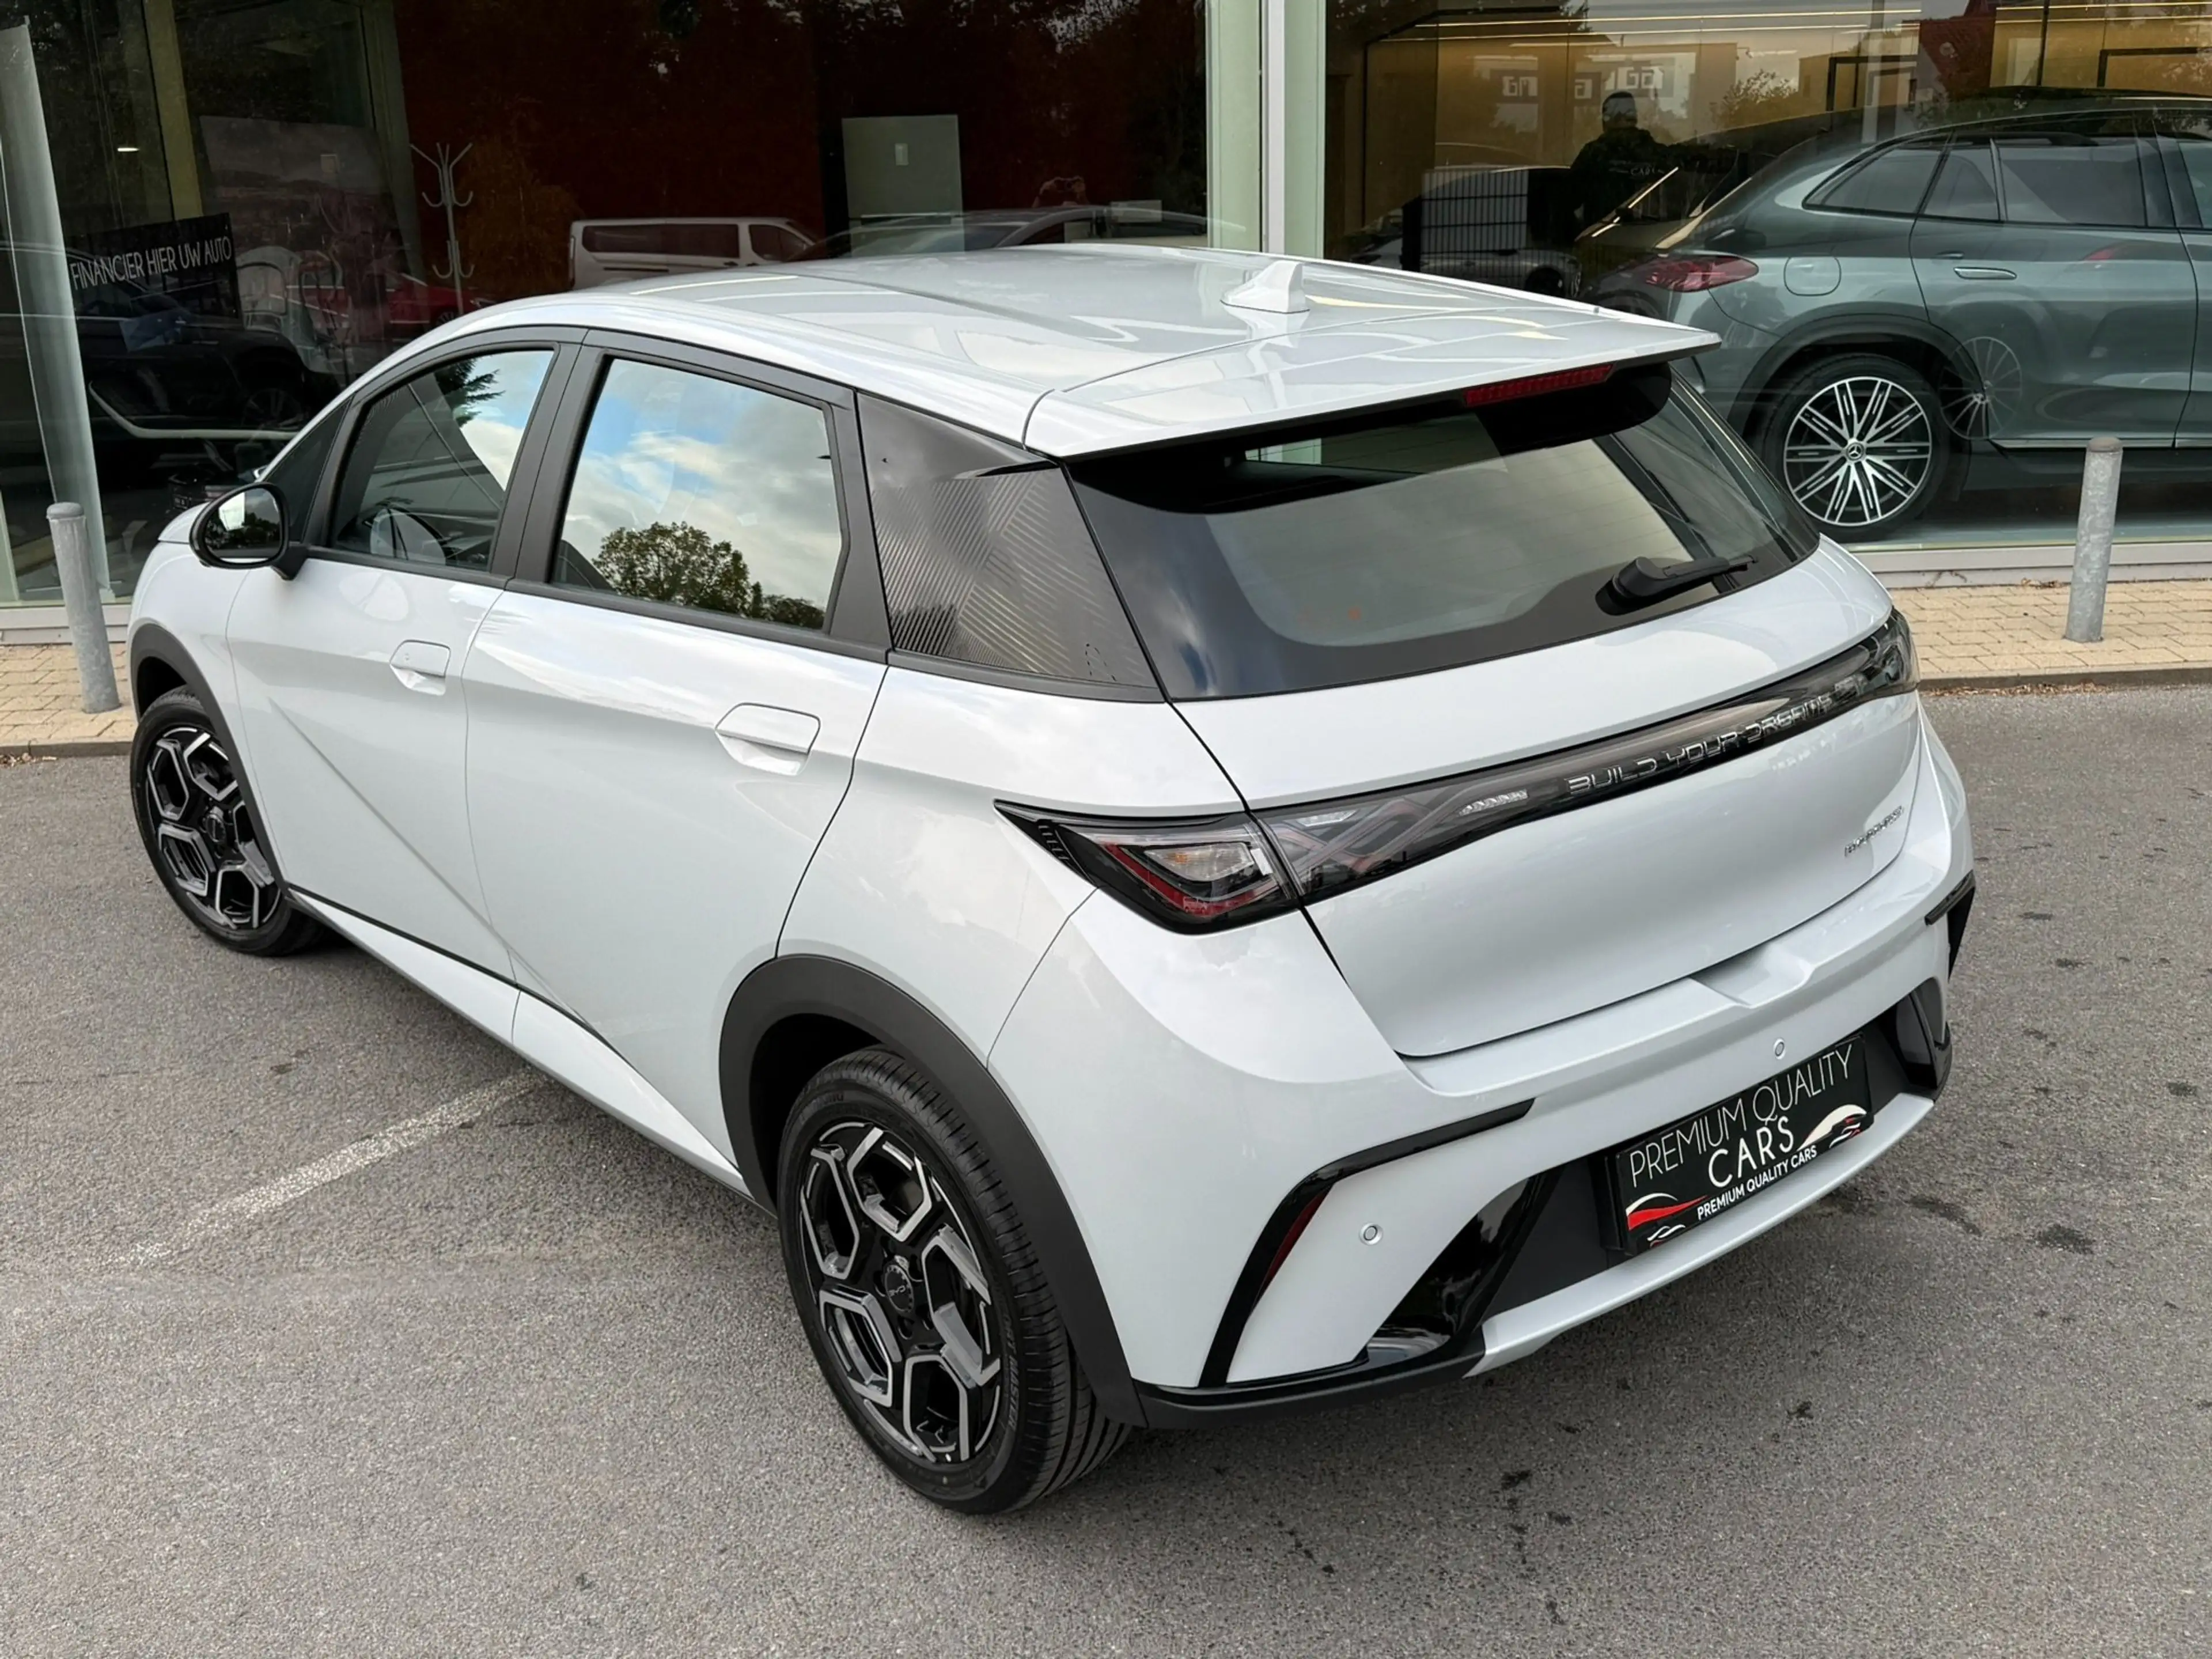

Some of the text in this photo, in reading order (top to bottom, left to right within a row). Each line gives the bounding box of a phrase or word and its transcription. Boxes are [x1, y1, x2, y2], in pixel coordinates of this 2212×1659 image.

[70, 236, 232, 290] FINANCIER HIER UW AUTO
[1567, 692, 1833, 795] BUILD YOUR DREAMS
[1629, 1044, 1853, 1188] PREMIUM QUALITY
[1708, 1116, 1794, 1188] CARS
[1697, 1145, 1818, 1220] PREMIUM QUALITY CARS
